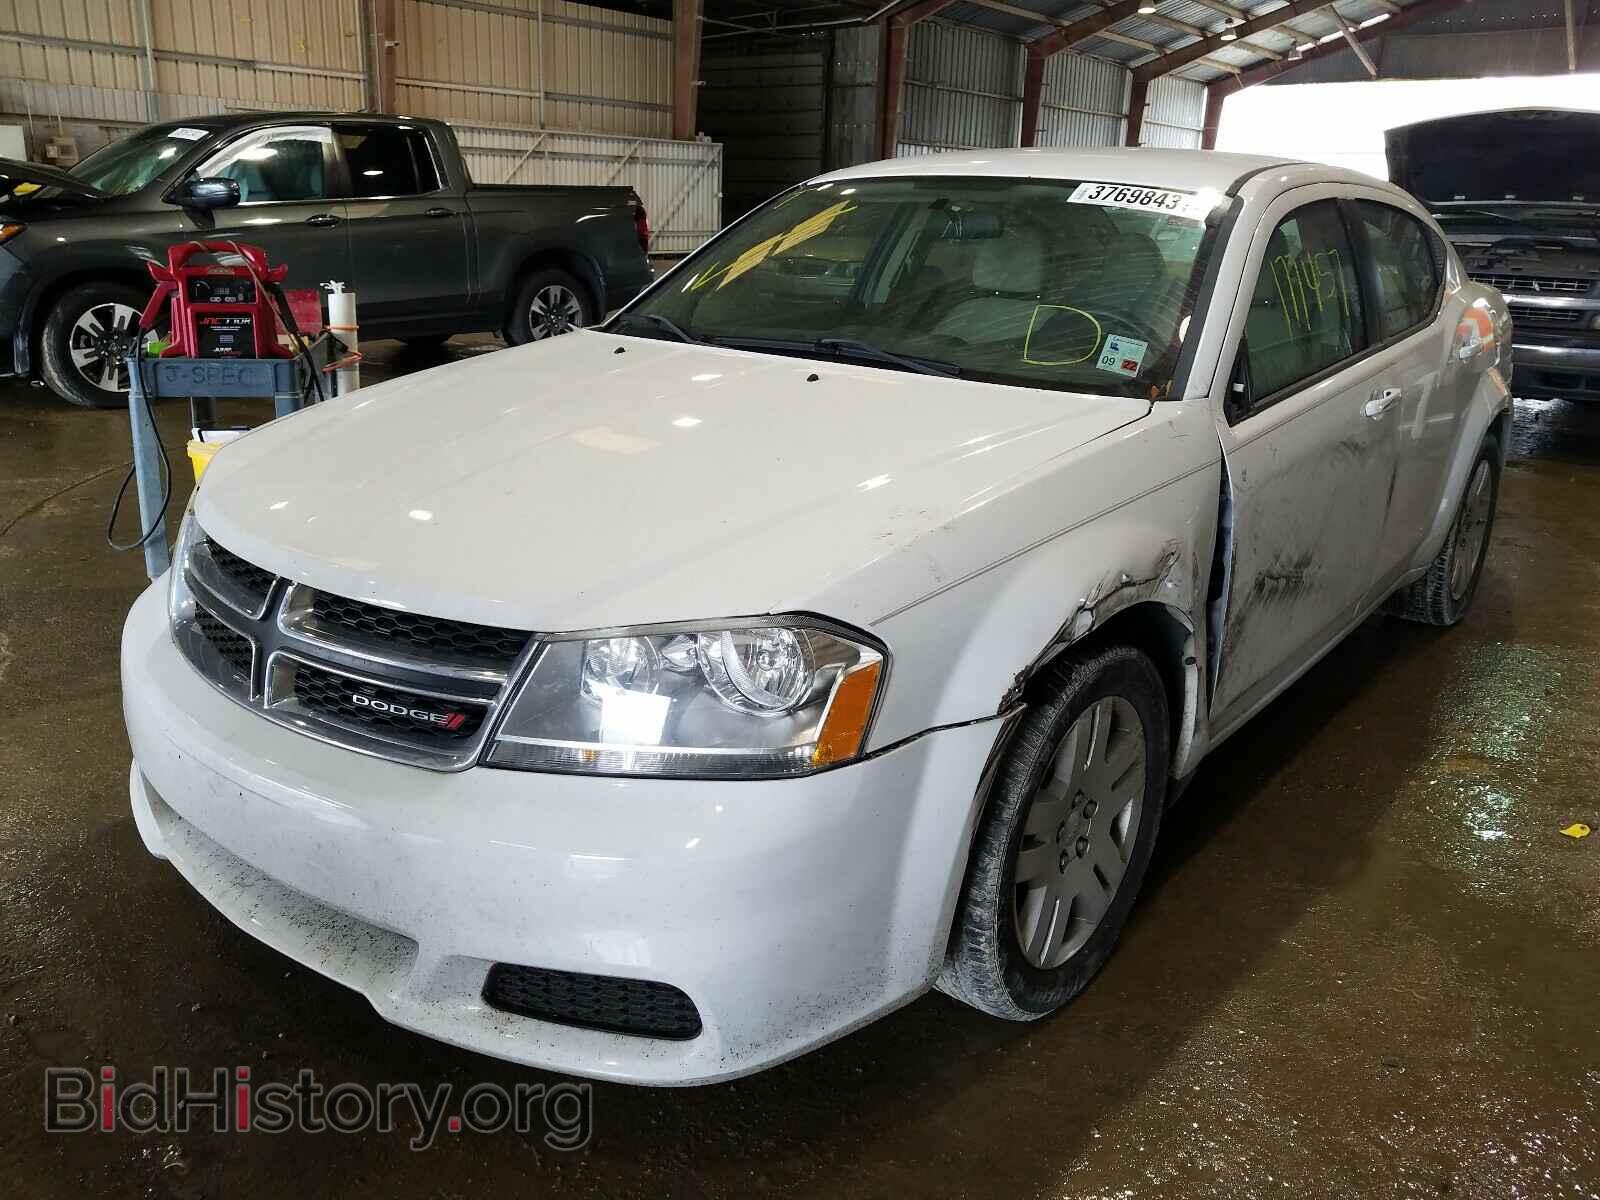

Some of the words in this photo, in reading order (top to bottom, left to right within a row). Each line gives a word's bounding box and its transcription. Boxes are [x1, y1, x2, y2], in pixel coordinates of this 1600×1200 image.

[1088, 185, 1190, 211] 3769843
[1101, 355, 1116, 366] 09
[352, 694, 449, 725] DODGE
